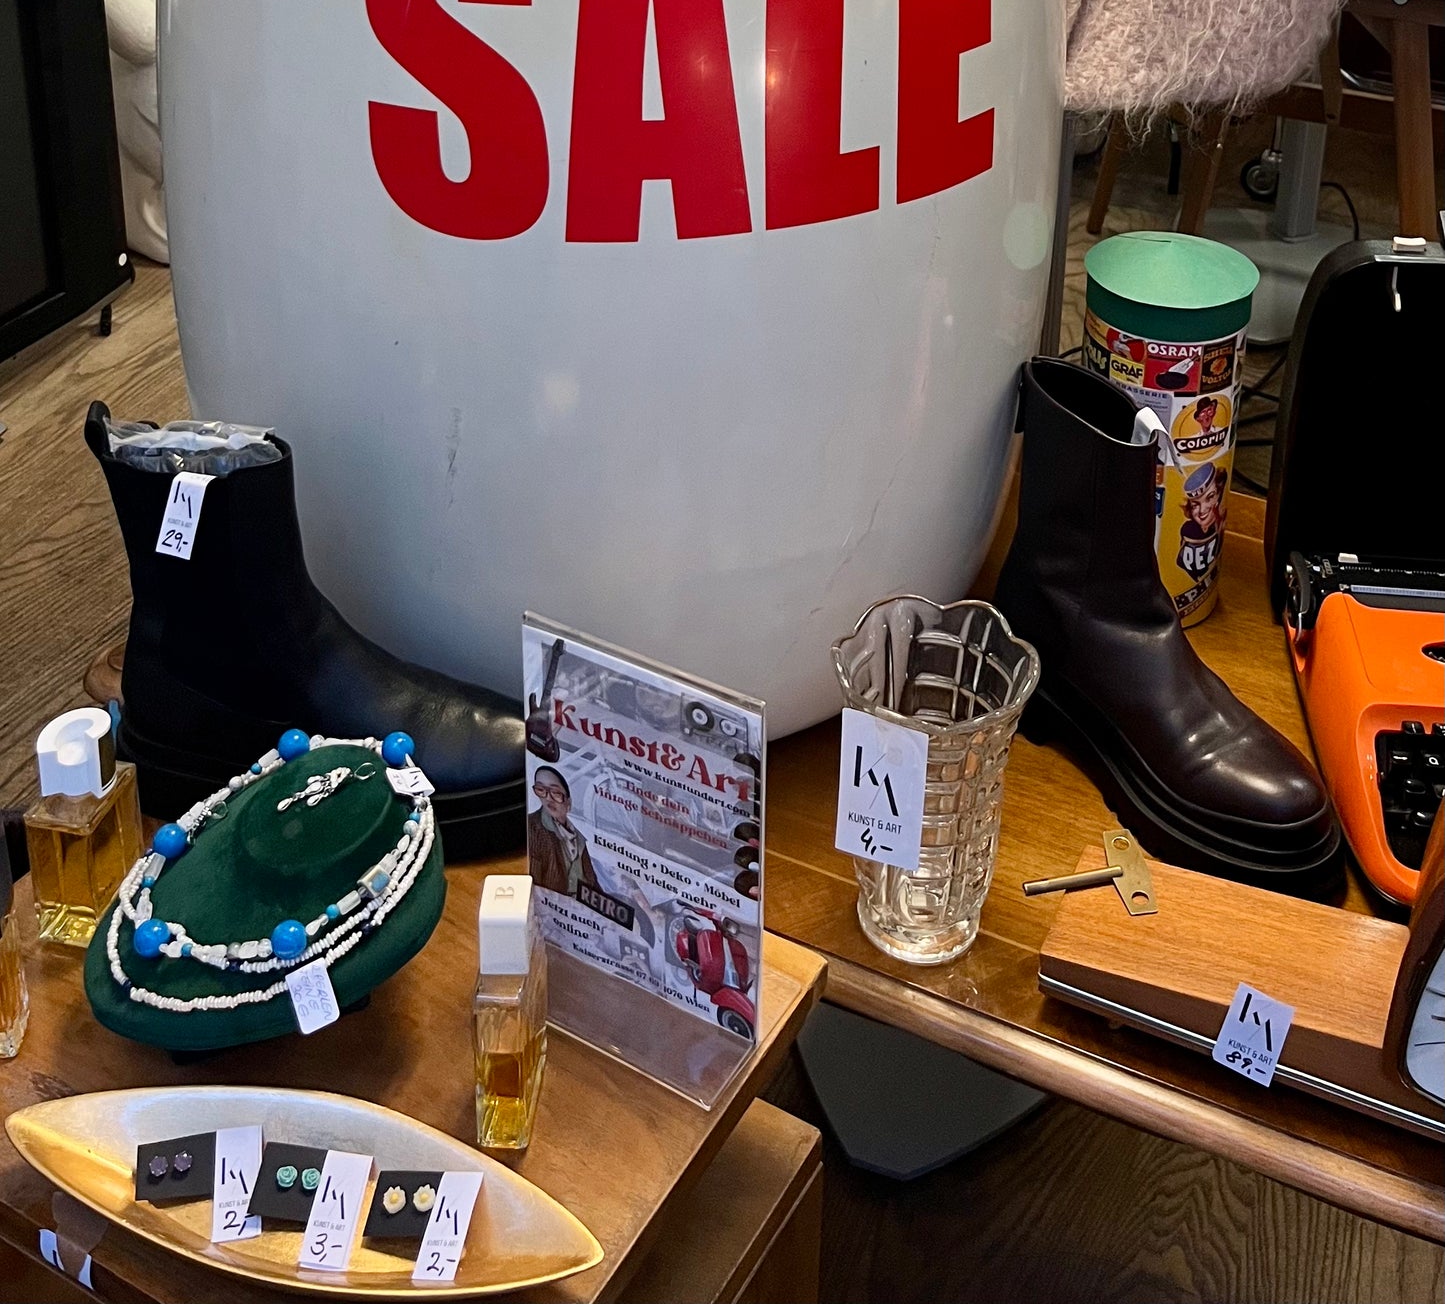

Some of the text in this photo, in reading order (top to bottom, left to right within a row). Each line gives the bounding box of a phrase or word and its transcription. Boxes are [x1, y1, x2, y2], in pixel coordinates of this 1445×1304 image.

[1147, 343, 1202, 358] OSRAM
[1111, 360, 1143, 379] GRAF
[1176, 430, 1226, 451] Colorin
[1182, 538, 1217, 571] PEZ
[593, 784, 639, 812] Vintage
[623, 758, 751, 818] www.kunstundart.com
[848, 810, 902, 835] KUNST & ART
[593, 834, 650, 870] Kleidung
[660, 863, 692, 886] Deko
[617, 860, 718, 911] und vieles mehr
[541, 896, 601, 931] Jetzt auch
[580, 886, 629, 925] RETRO
[552, 917, 589, 941] online
[663, 985, 684, 1000] 1070
[1228, 1037, 1251, 1056] KUNST
[1258, 1052, 1273, 1067] ART
